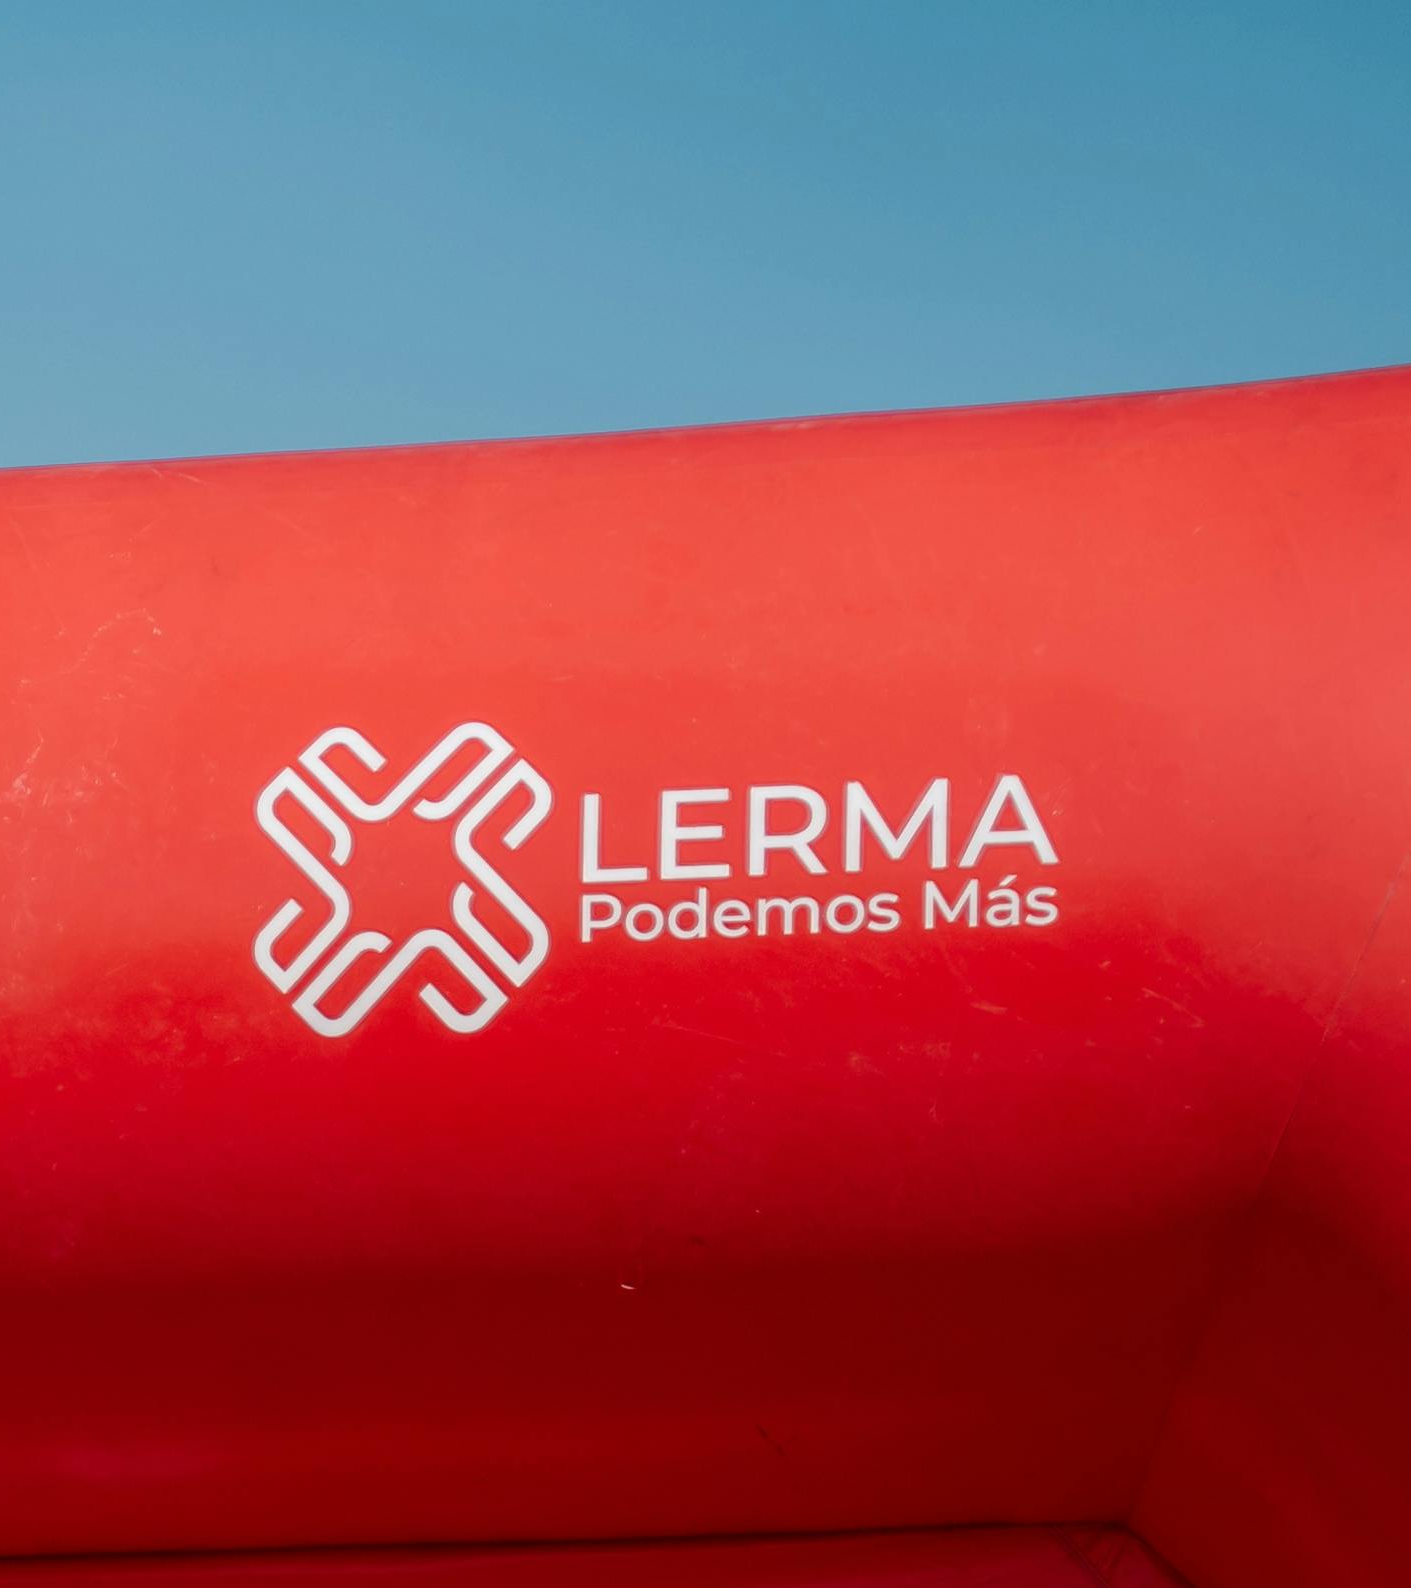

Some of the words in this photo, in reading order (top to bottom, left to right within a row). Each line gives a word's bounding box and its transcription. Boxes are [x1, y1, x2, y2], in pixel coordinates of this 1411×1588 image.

[580, 774, 1059, 883] LERMA
[580, 886, 902, 943] Podemos
[923, 874, 1058, 930] Más
